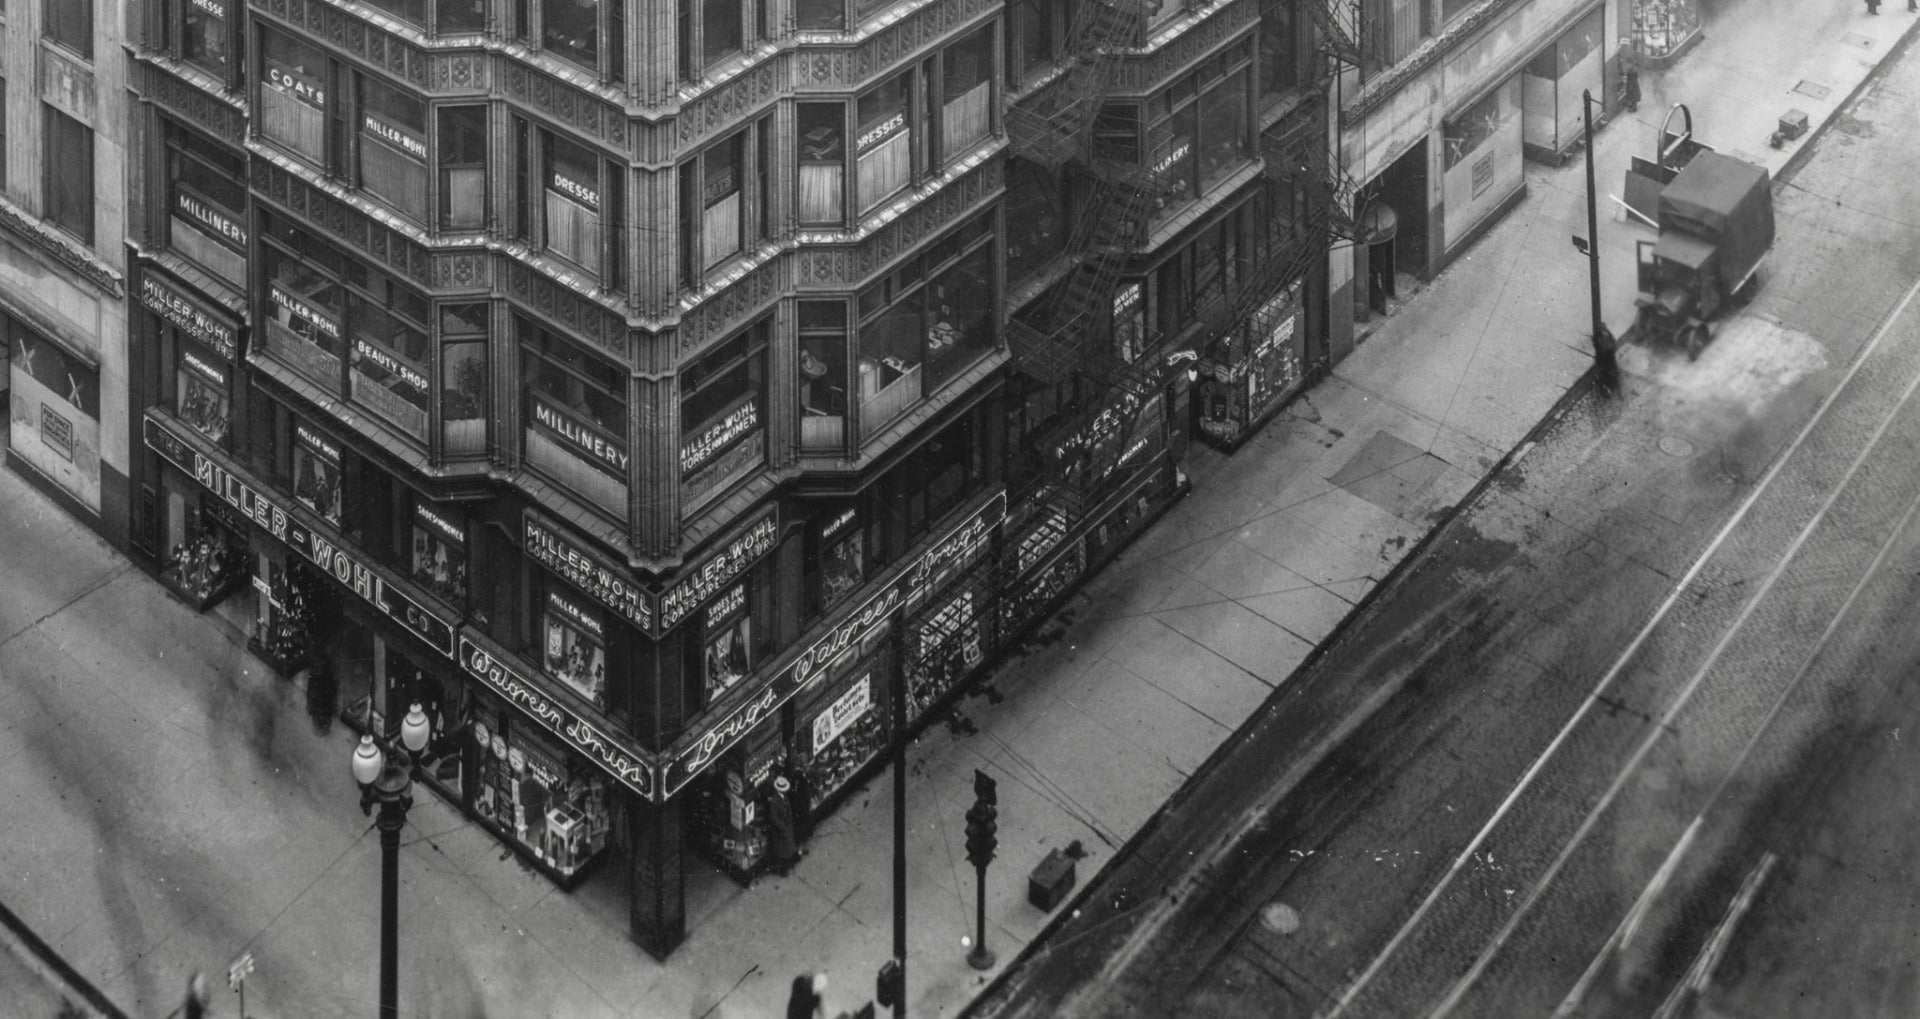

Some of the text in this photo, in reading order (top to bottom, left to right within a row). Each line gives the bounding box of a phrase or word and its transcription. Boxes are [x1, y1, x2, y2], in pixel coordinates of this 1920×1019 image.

[270, 68, 325, 104] COATS
[366, 117, 427, 158] MILLER-WOHL
[856, 113, 904, 151] DRESSES
[180, 195, 248, 245] MILLINERY
[272, 288, 340, 338] MILLER-WOHL
[358, 340, 398, 373] BEAUTY
[400, 366, 429, 391] SHOP
[536, 402, 629, 470] MILLINERY
[792, 588, 900, 684] Walgreen
[470, 650, 645, 787] Walgreen Drugs
